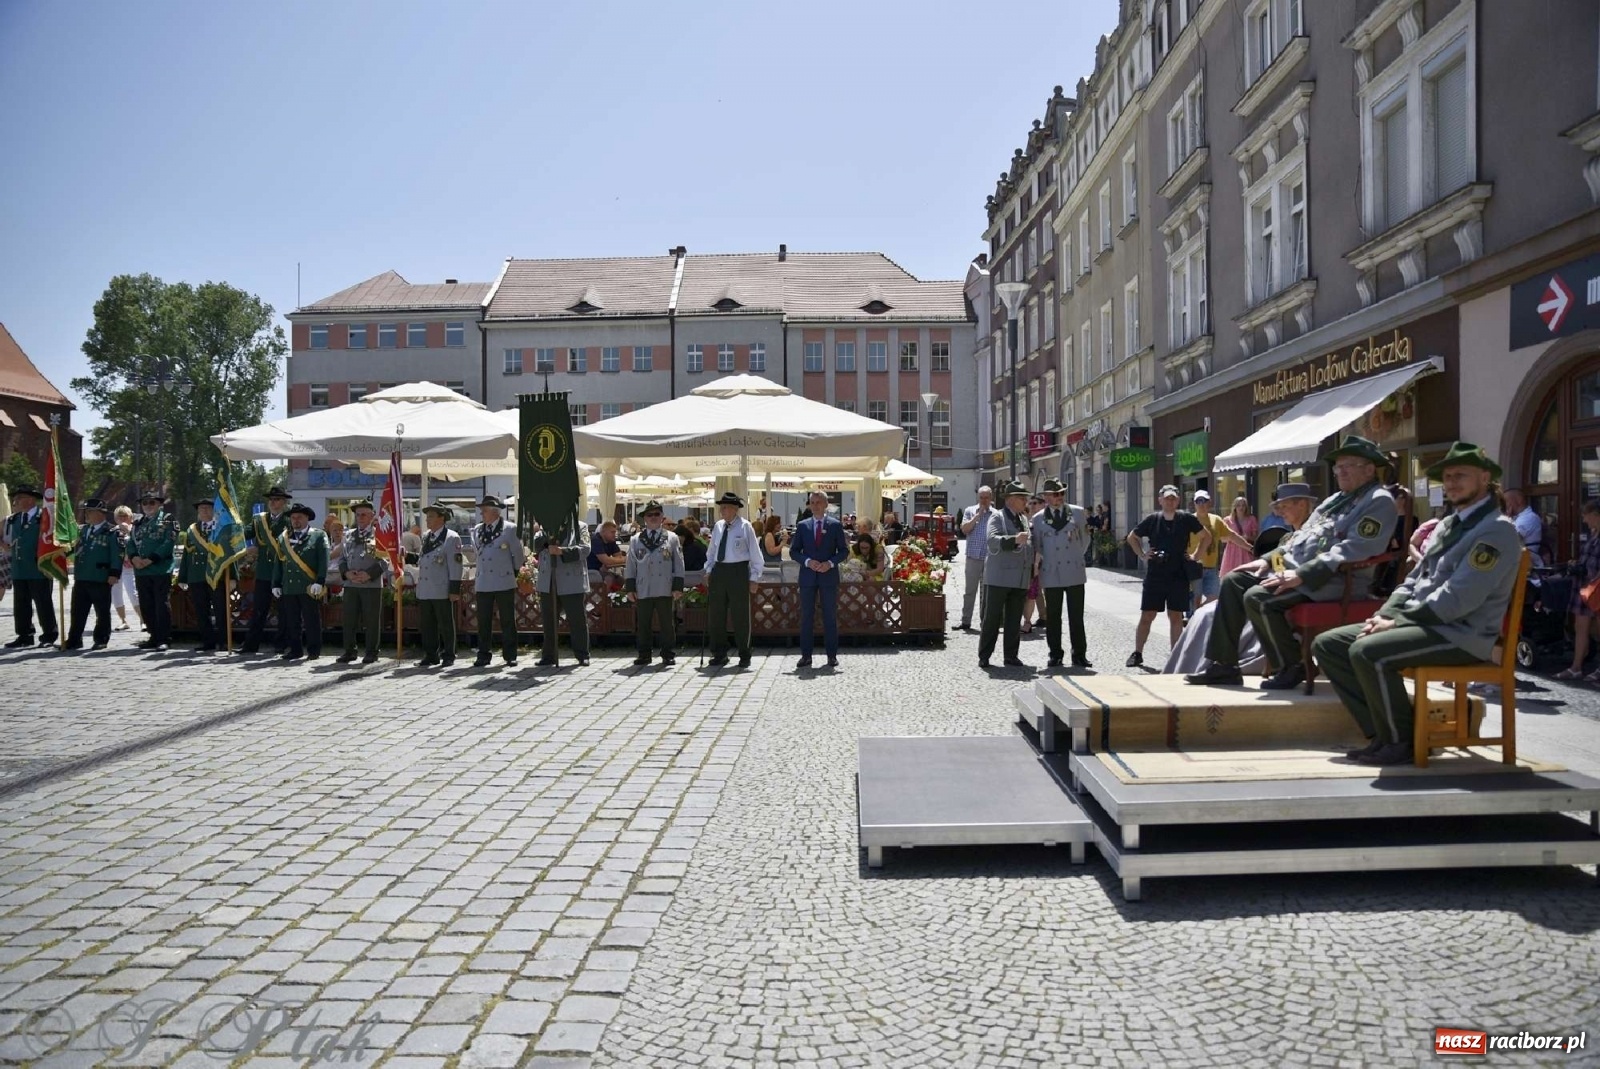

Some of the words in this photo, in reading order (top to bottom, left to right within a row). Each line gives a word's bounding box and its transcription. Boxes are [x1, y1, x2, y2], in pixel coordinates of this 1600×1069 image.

[1253, 370, 1309, 405] Manufaktura
[1309, 353, 1349, 388] Lodów
[1350, 329, 1413, 374] Gałeczka
[666, 436, 727, 449] Manufaktura
[728, 435, 761, 448] Lodów
[1114, 452, 1151, 463] żabka
